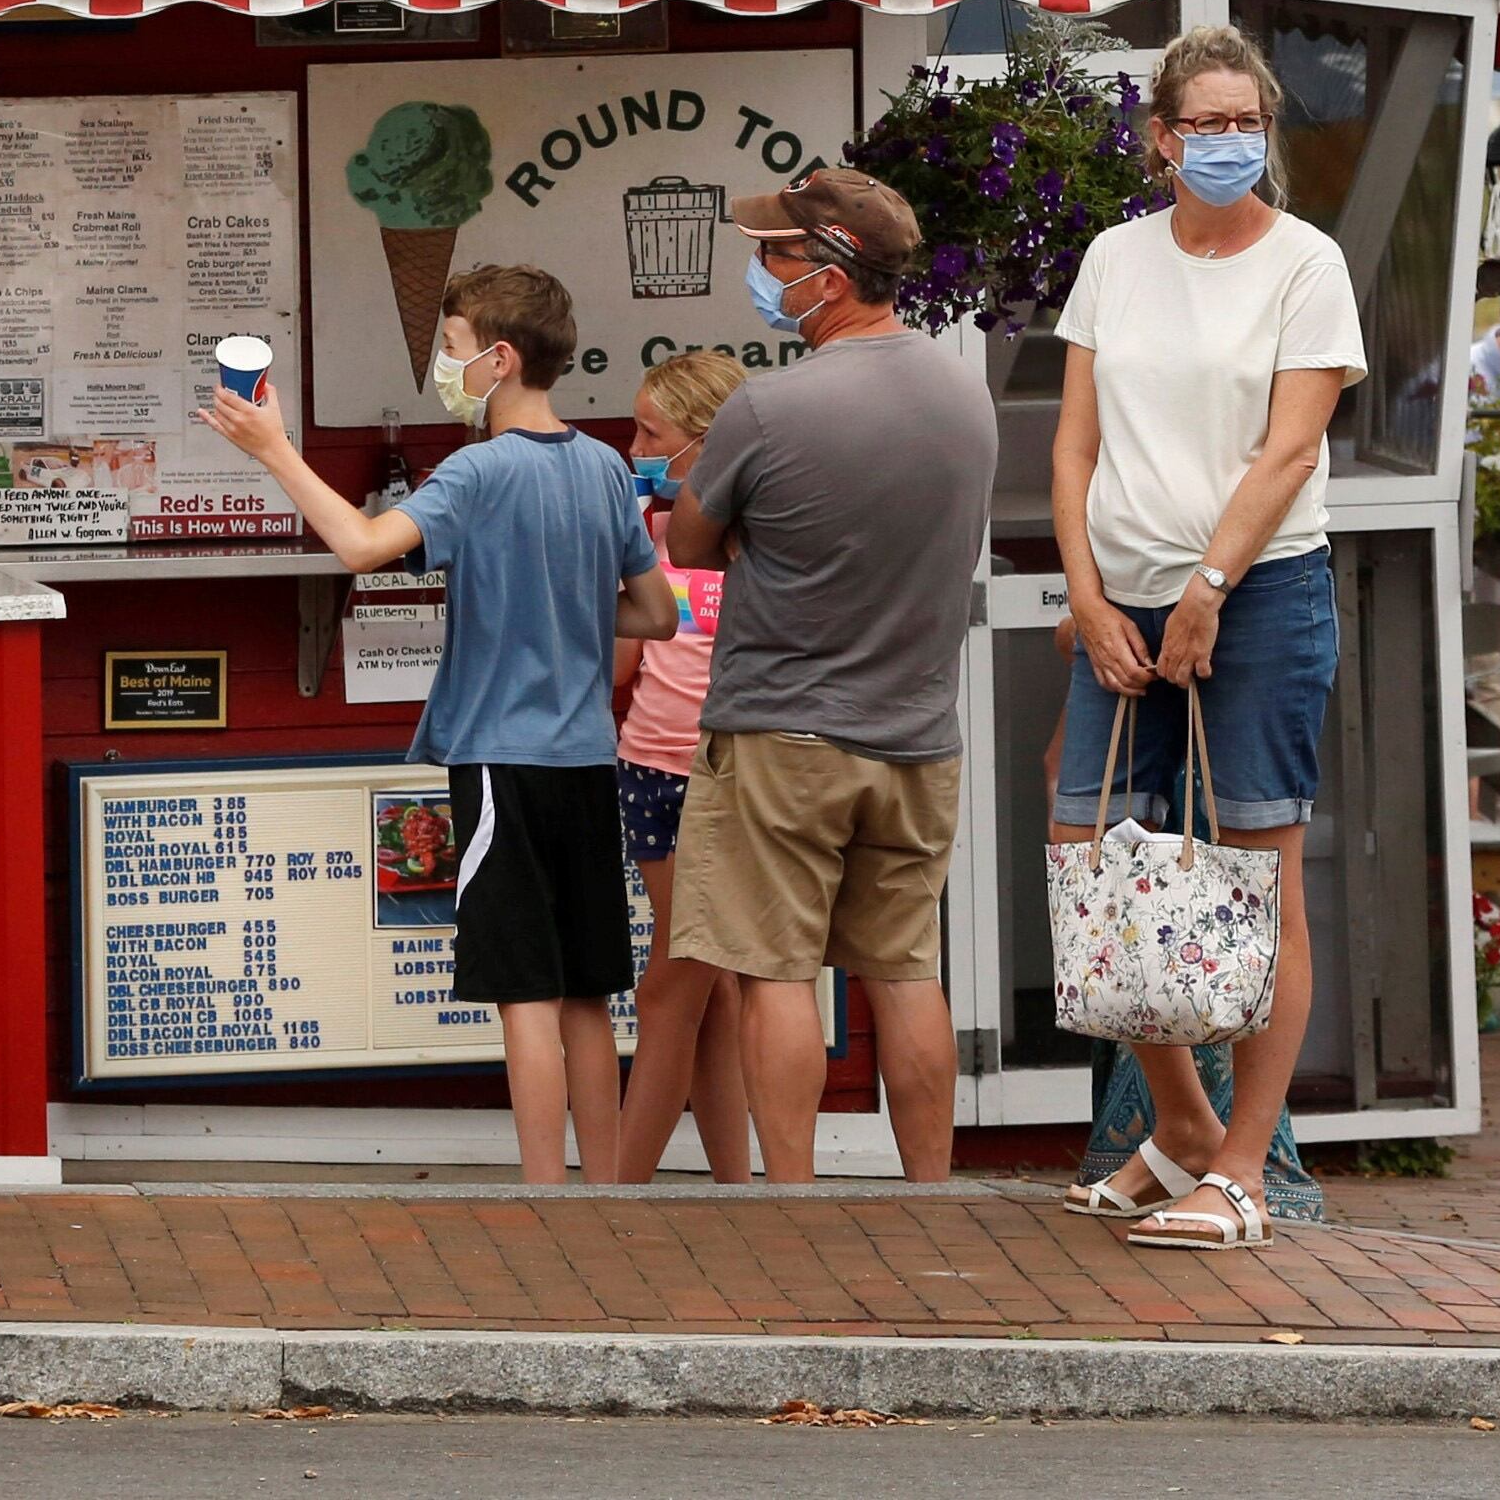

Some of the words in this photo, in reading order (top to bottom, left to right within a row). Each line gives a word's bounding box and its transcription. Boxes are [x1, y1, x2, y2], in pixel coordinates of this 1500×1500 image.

[505, 89, 706, 207] ROUND
[77, 212, 104, 220] Fresh
[107, 211, 136, 219] Maine
[188, 217, 220, 228] Crab
[226, 216, 269, 227] Cakes
[73, 223, 119, 232] Crabmeat
[122, 223, 140, 231] Roll
[87, 286, 114, 295] Maine
[117, 285, 147, 294] Clams
[74, 351, 100, 360] Fresh
[104, 351, 110, 359] &
[114, 350, 162, 359] Delicious!
[4, 490, 29, 500] FEED
[32, 490, 70, 499] ANYONE
[160, 494, 213, 513] Red's
[222, 495, 264, 511] Eats
[16, 503, 41, 512] THEM
[45, 503, 76, 511] TWICE
[78, 502, 97, 510] AND
[1, 514, 52, 524] SOMETHING
[60, 514, 88, 523] RIGHT
[133, 521, 163, 535] This
[170, 521, 182, 533] Is
[188, 520, 224, 533] How
[230, 519, 256, 532] We
[262, 518, 291, 532] Roll
[28, 528, 56, 540] ALLEN
[363, 575, 408, 588] LOCAL
[417, 573, 445, 586] HON
[359, 648, 383, 658] Cash
[387, 648, 398, 656] Or
[401, 647, 431, 655] Check
[357, 661, 378, 669] ATM
[382, 661, 393, 670] by
[396, 659, 420, 668] front
[423, 658, 439, 666] win
[120, 676, 149, 688] Best
[153, 676, 166, 687] of
[170, 675, 211, 687] Maine
[158, 689, 174, 697] 2019
[104, 799, 197, 814] HAMBURGER
[213, 797, 246, 811] 385
[104, 816, 141, 829] WITH
[147, 814, 202, 827] BACON
[214, 812, 246, 825] 540
[105, 830, 155, 843] ROYAL
[213, 826, 247, 839] 485
[105, 845, 158, 859] BACON
[159, 842, 210, 856] ROYAL
[215, 842, 247, 854] 615
[105, 859, 133, 873] DBL
[139, 857, 236, 872] HAMBURGER
[246, 854, 275, 867] 770
[287, 853, 314, 866] ROY
[326, 852, 353, 864] 870
[107, 875, 138, 888] DBL
[142, 872, 190, 886] BACON
[196, 871, 215, 884] HB
[244, 869, 273, 882] 945
[288, 868, 317, 881] ROY
[326, 866, 362, 879] 1045
[107, 893, 149, 906] BOSS
[159, 890, 219, 904] BURGER
[245, 887, 274, 900] 705
[107, 922, 226, 939] CHEESEBURGER
[244, 920, 275, 933] 455
[107, 940, 148, 953] WITH
[154, 938, 207, 951] BACON
[244, 935, 276, 948] 600
[393, 939, 443, 953] MAINE
[107, 954, 157, 968] ROYAL
[244, 950, 275, 963] 545
[107, 969, 160, 983] BACON
[165, 966, 212, 980] ROYAL
[244, 964, 276, 977] 675
[395, 961, 456, 975] LOBSTE
[107, 985, 134, 997] DBL
[139, 980, 257, 996] CHEESEBURGER
[269, 978, 300, 991] 890
[108, 999, 135, 1012] DBL
[139, 998, 159, 1011] CB
[166, 995, 215, 1009] ROYAL
[233, 994, 263, 1007] 990
[396, 990, 459, 1004] LOBSTE
[108, 1014, 136, 1027] DBL
[140, 1012, 191, 1025] BACON
[197, 1010, 216, 1024] CB
[234, 1008, 272, 1022] 1065
[438, 1010, 491, 1024] MODEL
[108, 1029, 137, 1042] DBL
[140, 1026, 193, 1040] BACON
[197, 1025, 216, 1038] CB
[222, 1023, 272, 1037] ROYAL
[283, 1021, 319, 1034] 1165
[108, 1043, 148, 1056] BOSS
[153, 1038, 276, 1055] CHEESEBURGER
[289, 1036, 320, 1049] 840
